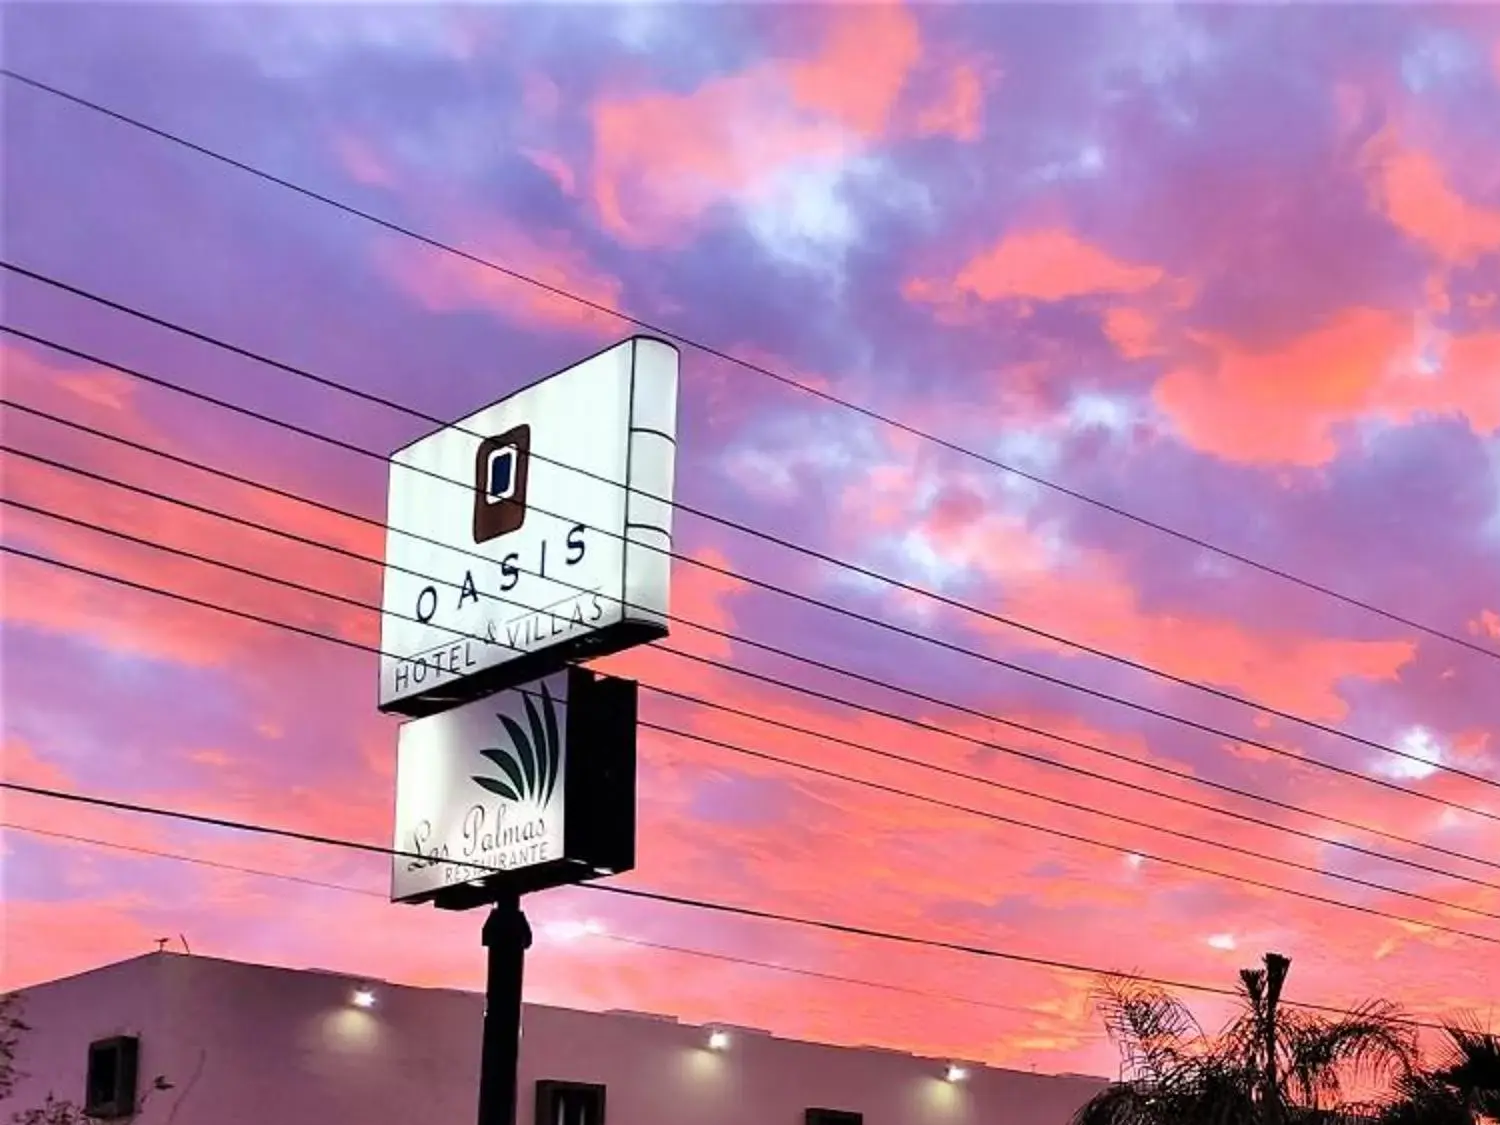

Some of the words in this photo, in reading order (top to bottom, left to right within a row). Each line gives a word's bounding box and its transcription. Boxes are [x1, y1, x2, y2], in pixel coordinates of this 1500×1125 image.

[416, 523, 586, 623] OASIS
[395, 642, 476, 692] HOTEL
[506, 594, 603, 648] VILLAS
[407, 819, 450, 872] Las
[463, 803, 546, 857] Palmas
